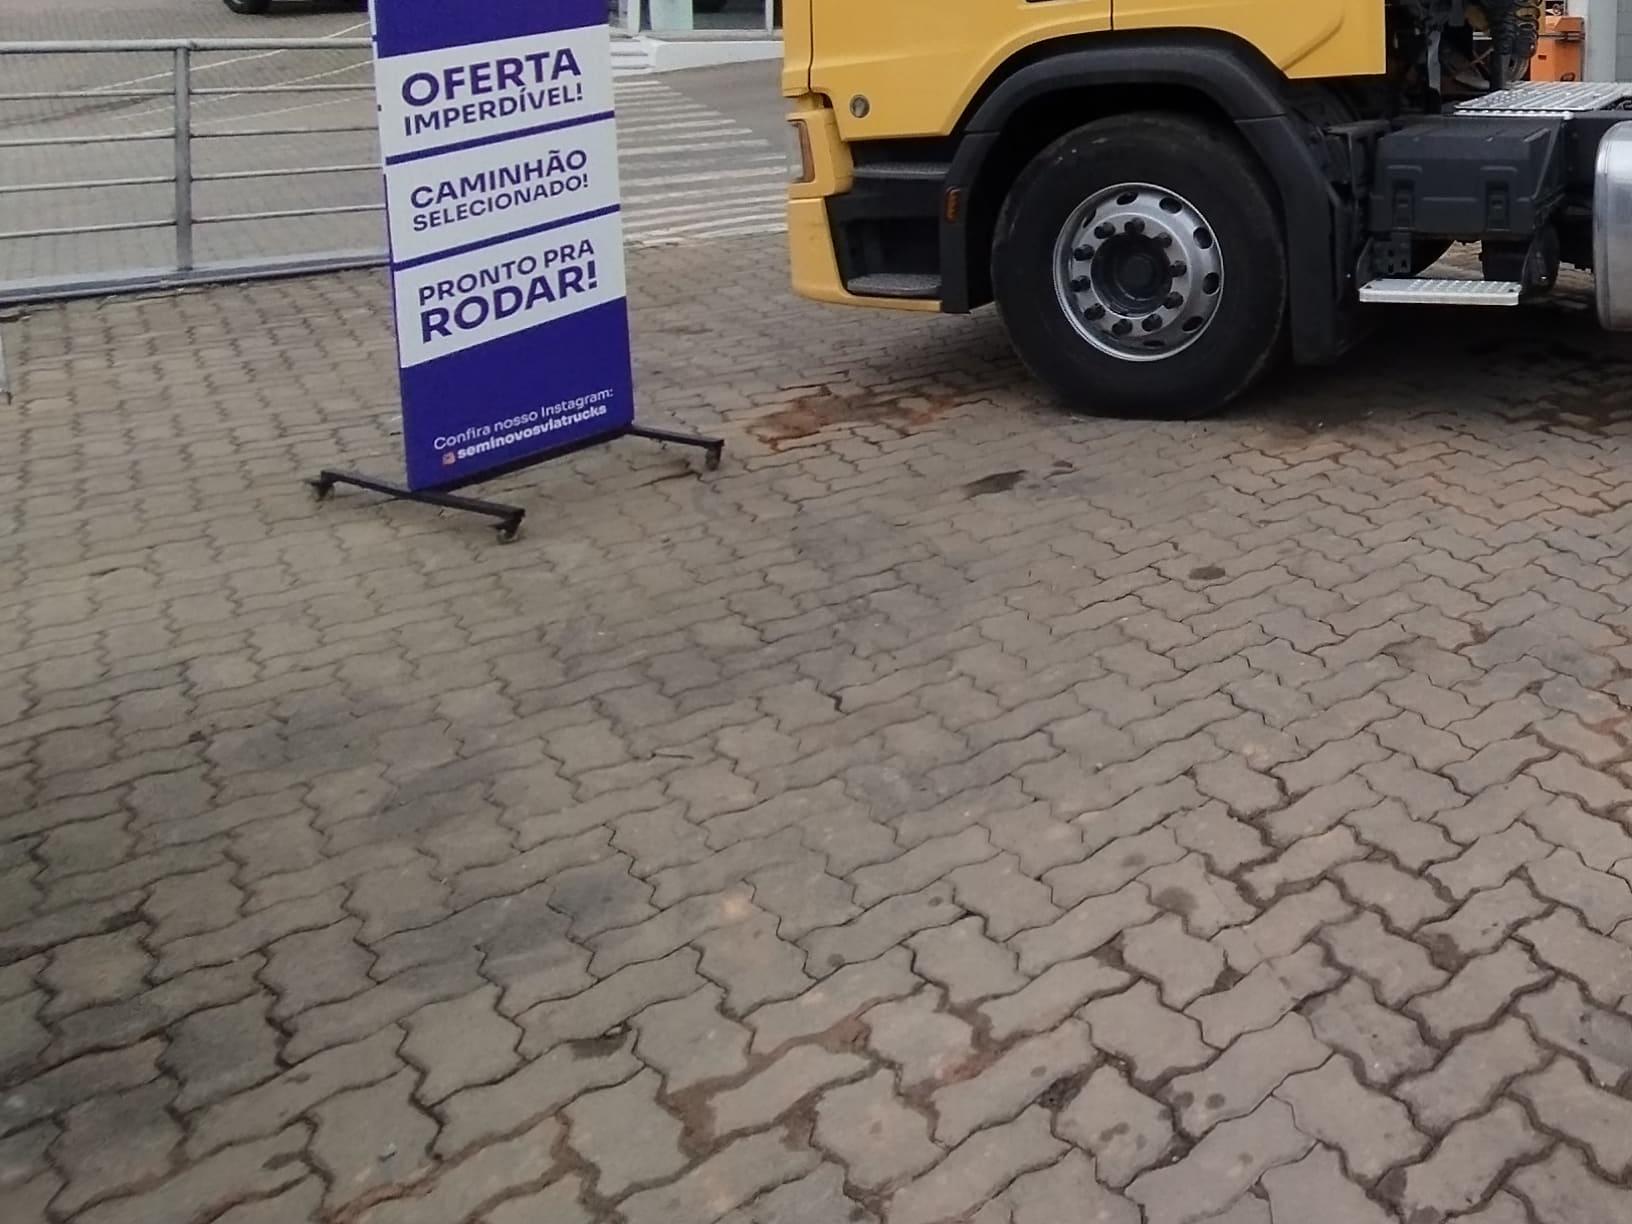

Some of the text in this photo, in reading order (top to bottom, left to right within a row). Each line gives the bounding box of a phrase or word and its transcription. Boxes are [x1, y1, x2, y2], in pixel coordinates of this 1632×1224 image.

[401, 47, 582, 107] OFERTA
[404, 82, 583, 137] IMPERDÍVEL!
[410, 149, 587, 209] CAMINHÃO
[413, 173, 589, 232] SELECIONADO!
[419, 239, 595, 306] PRONTO PRA
[420, 260, 598, 344] RODAR!
[433, 387, 614, 450] Confira nosso Instagram:
[457, 404, 607, 460] seminovosviatrucks
